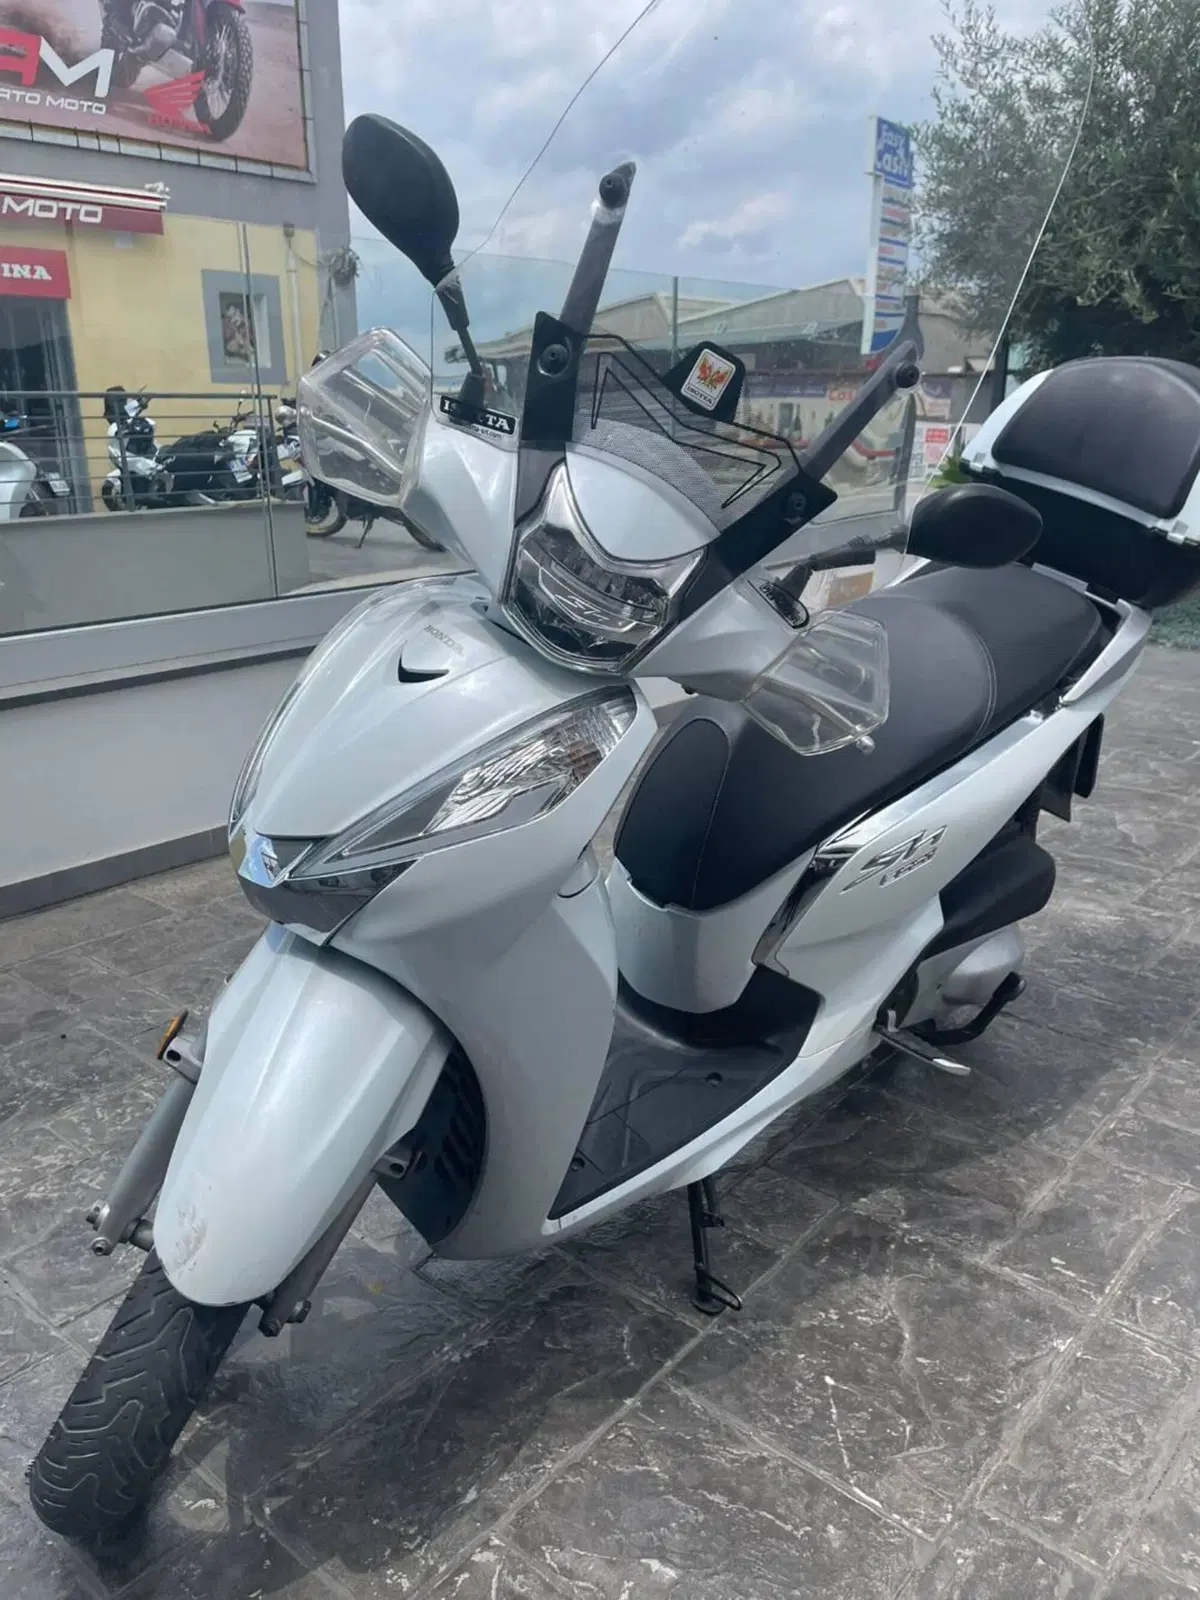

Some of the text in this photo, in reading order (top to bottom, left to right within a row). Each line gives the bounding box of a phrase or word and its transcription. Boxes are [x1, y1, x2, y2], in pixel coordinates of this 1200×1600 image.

[45, 95, 107, 115] MOTO
[2, 195, 103, 224] MOTO
[1, 263, 53, 281] INA
[443, 399, 511, 431] ITA
